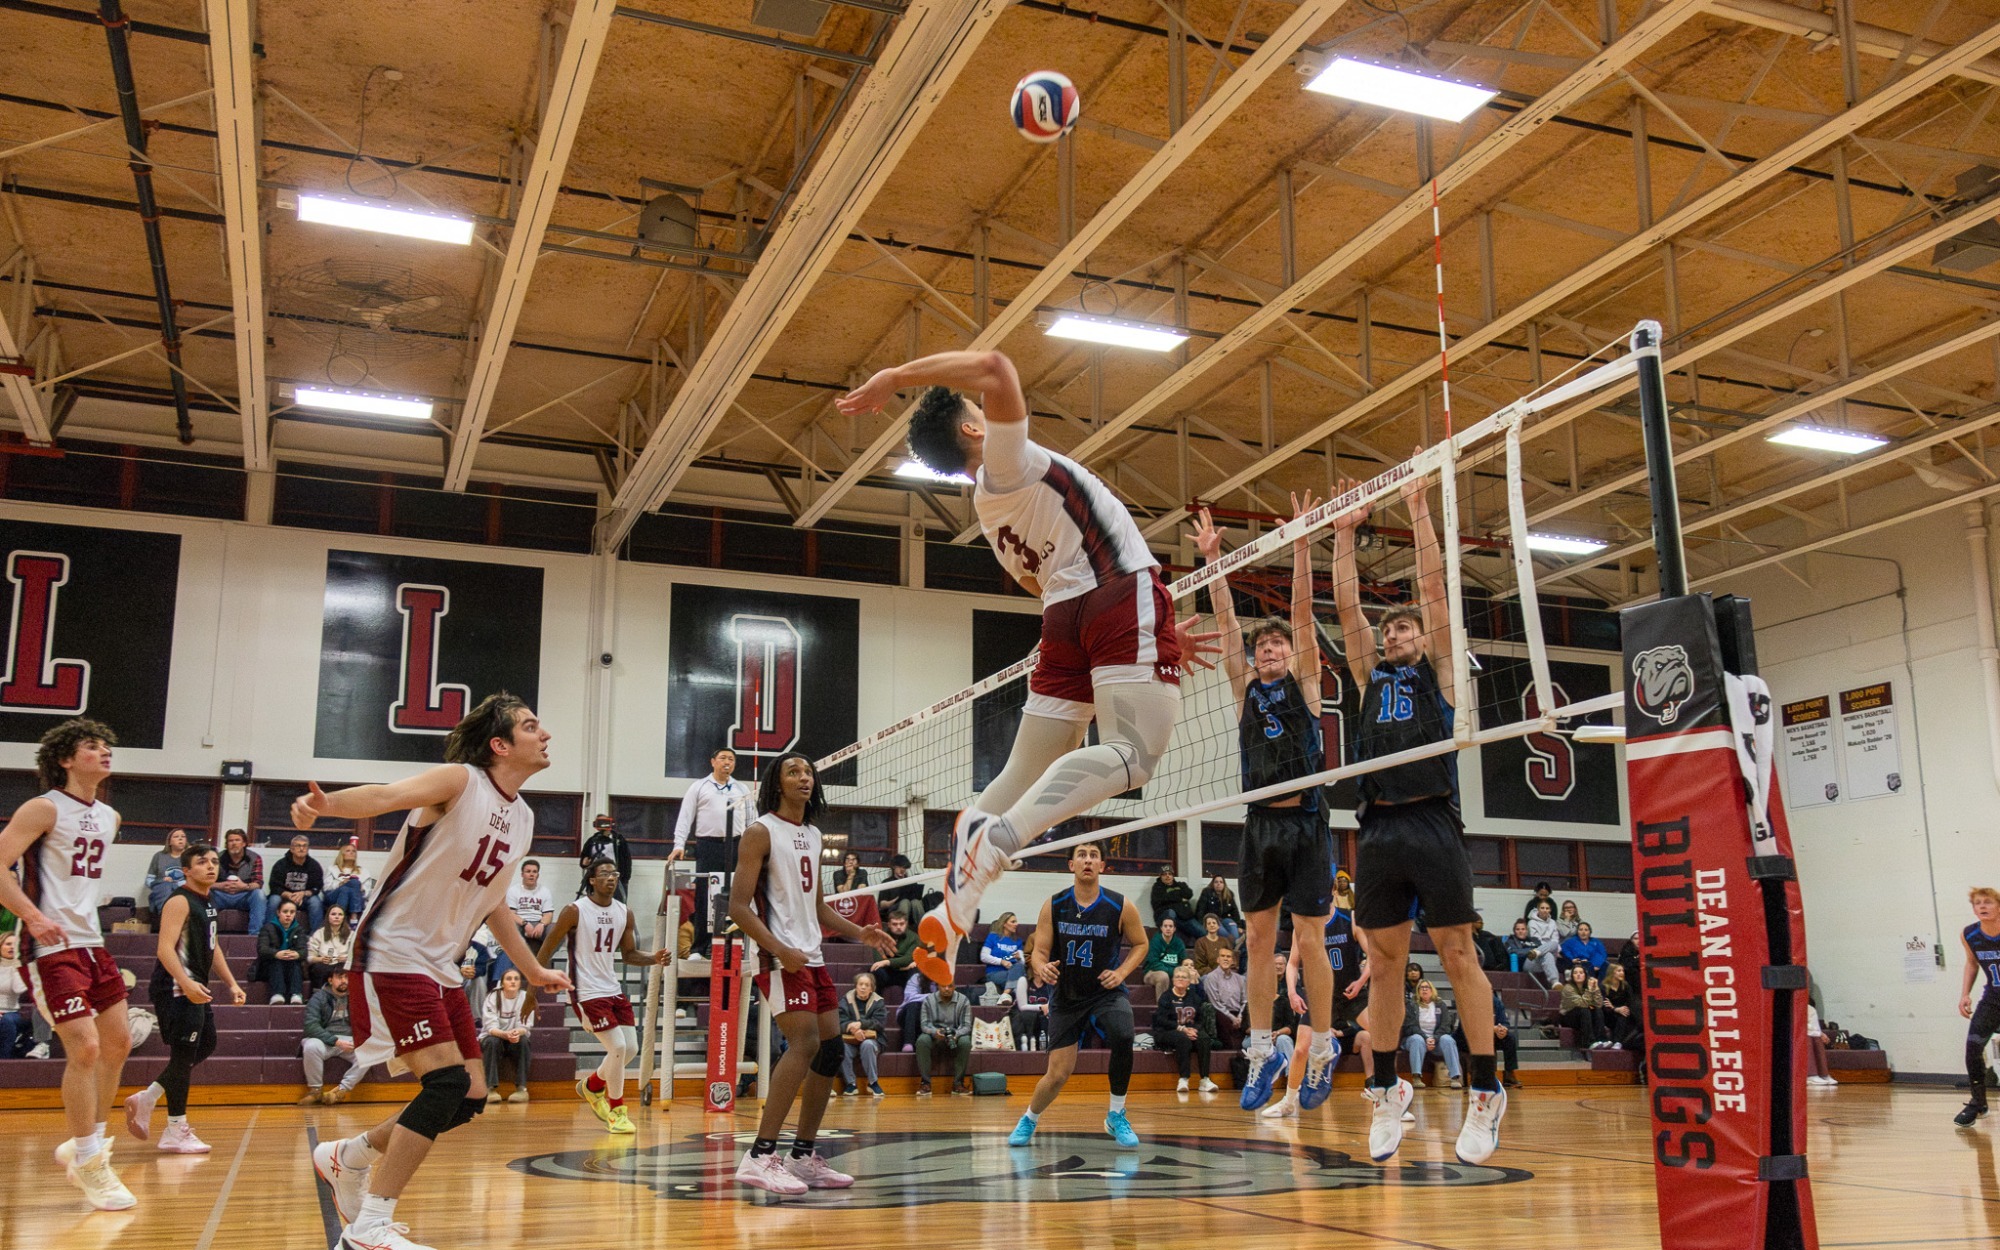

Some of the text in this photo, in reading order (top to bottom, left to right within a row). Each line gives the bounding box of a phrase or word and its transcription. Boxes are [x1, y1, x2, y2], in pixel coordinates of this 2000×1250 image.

[1304, 460, 1414, 528] DEAN COLLEGE VOLLEYBALL
[1176, 541, 1260, 593] DEAN COLLEGE VOLLEYBALL
[0, 550, 91, 716] L
[388, 583, 471, 736] L
[727, 614, 802, 757] D
[1376, 682, 1413, 723] 16
[1521, 680, 1575, 800] S
[489, 812, 511, 835] DEAN
[71, 836, 104, 879] 22
[459, 834, 511, 888] 15
[800, 855, 813, 893] 9
[594, 928, 614, 953] 14
[1058, 921, 1109, 938] WHEATON
[1905, 941, 1926, 950] DEAN
[1066, 939, 1094, 968] 14
[65, 996, 86, 1014] 22
[801, 991, 809, 1005] 9
[1636, 815, 1716, 1169] BULLDOGS
[1695, 868, 1747, 1113] DEAN COLLEGE
[189, 1031, 198, 1043] 8
[413, 1019, 433, 1042] 15
[598, 1017, 609, 1028] 14
[719, 1022, 728, 1076] sports imports
